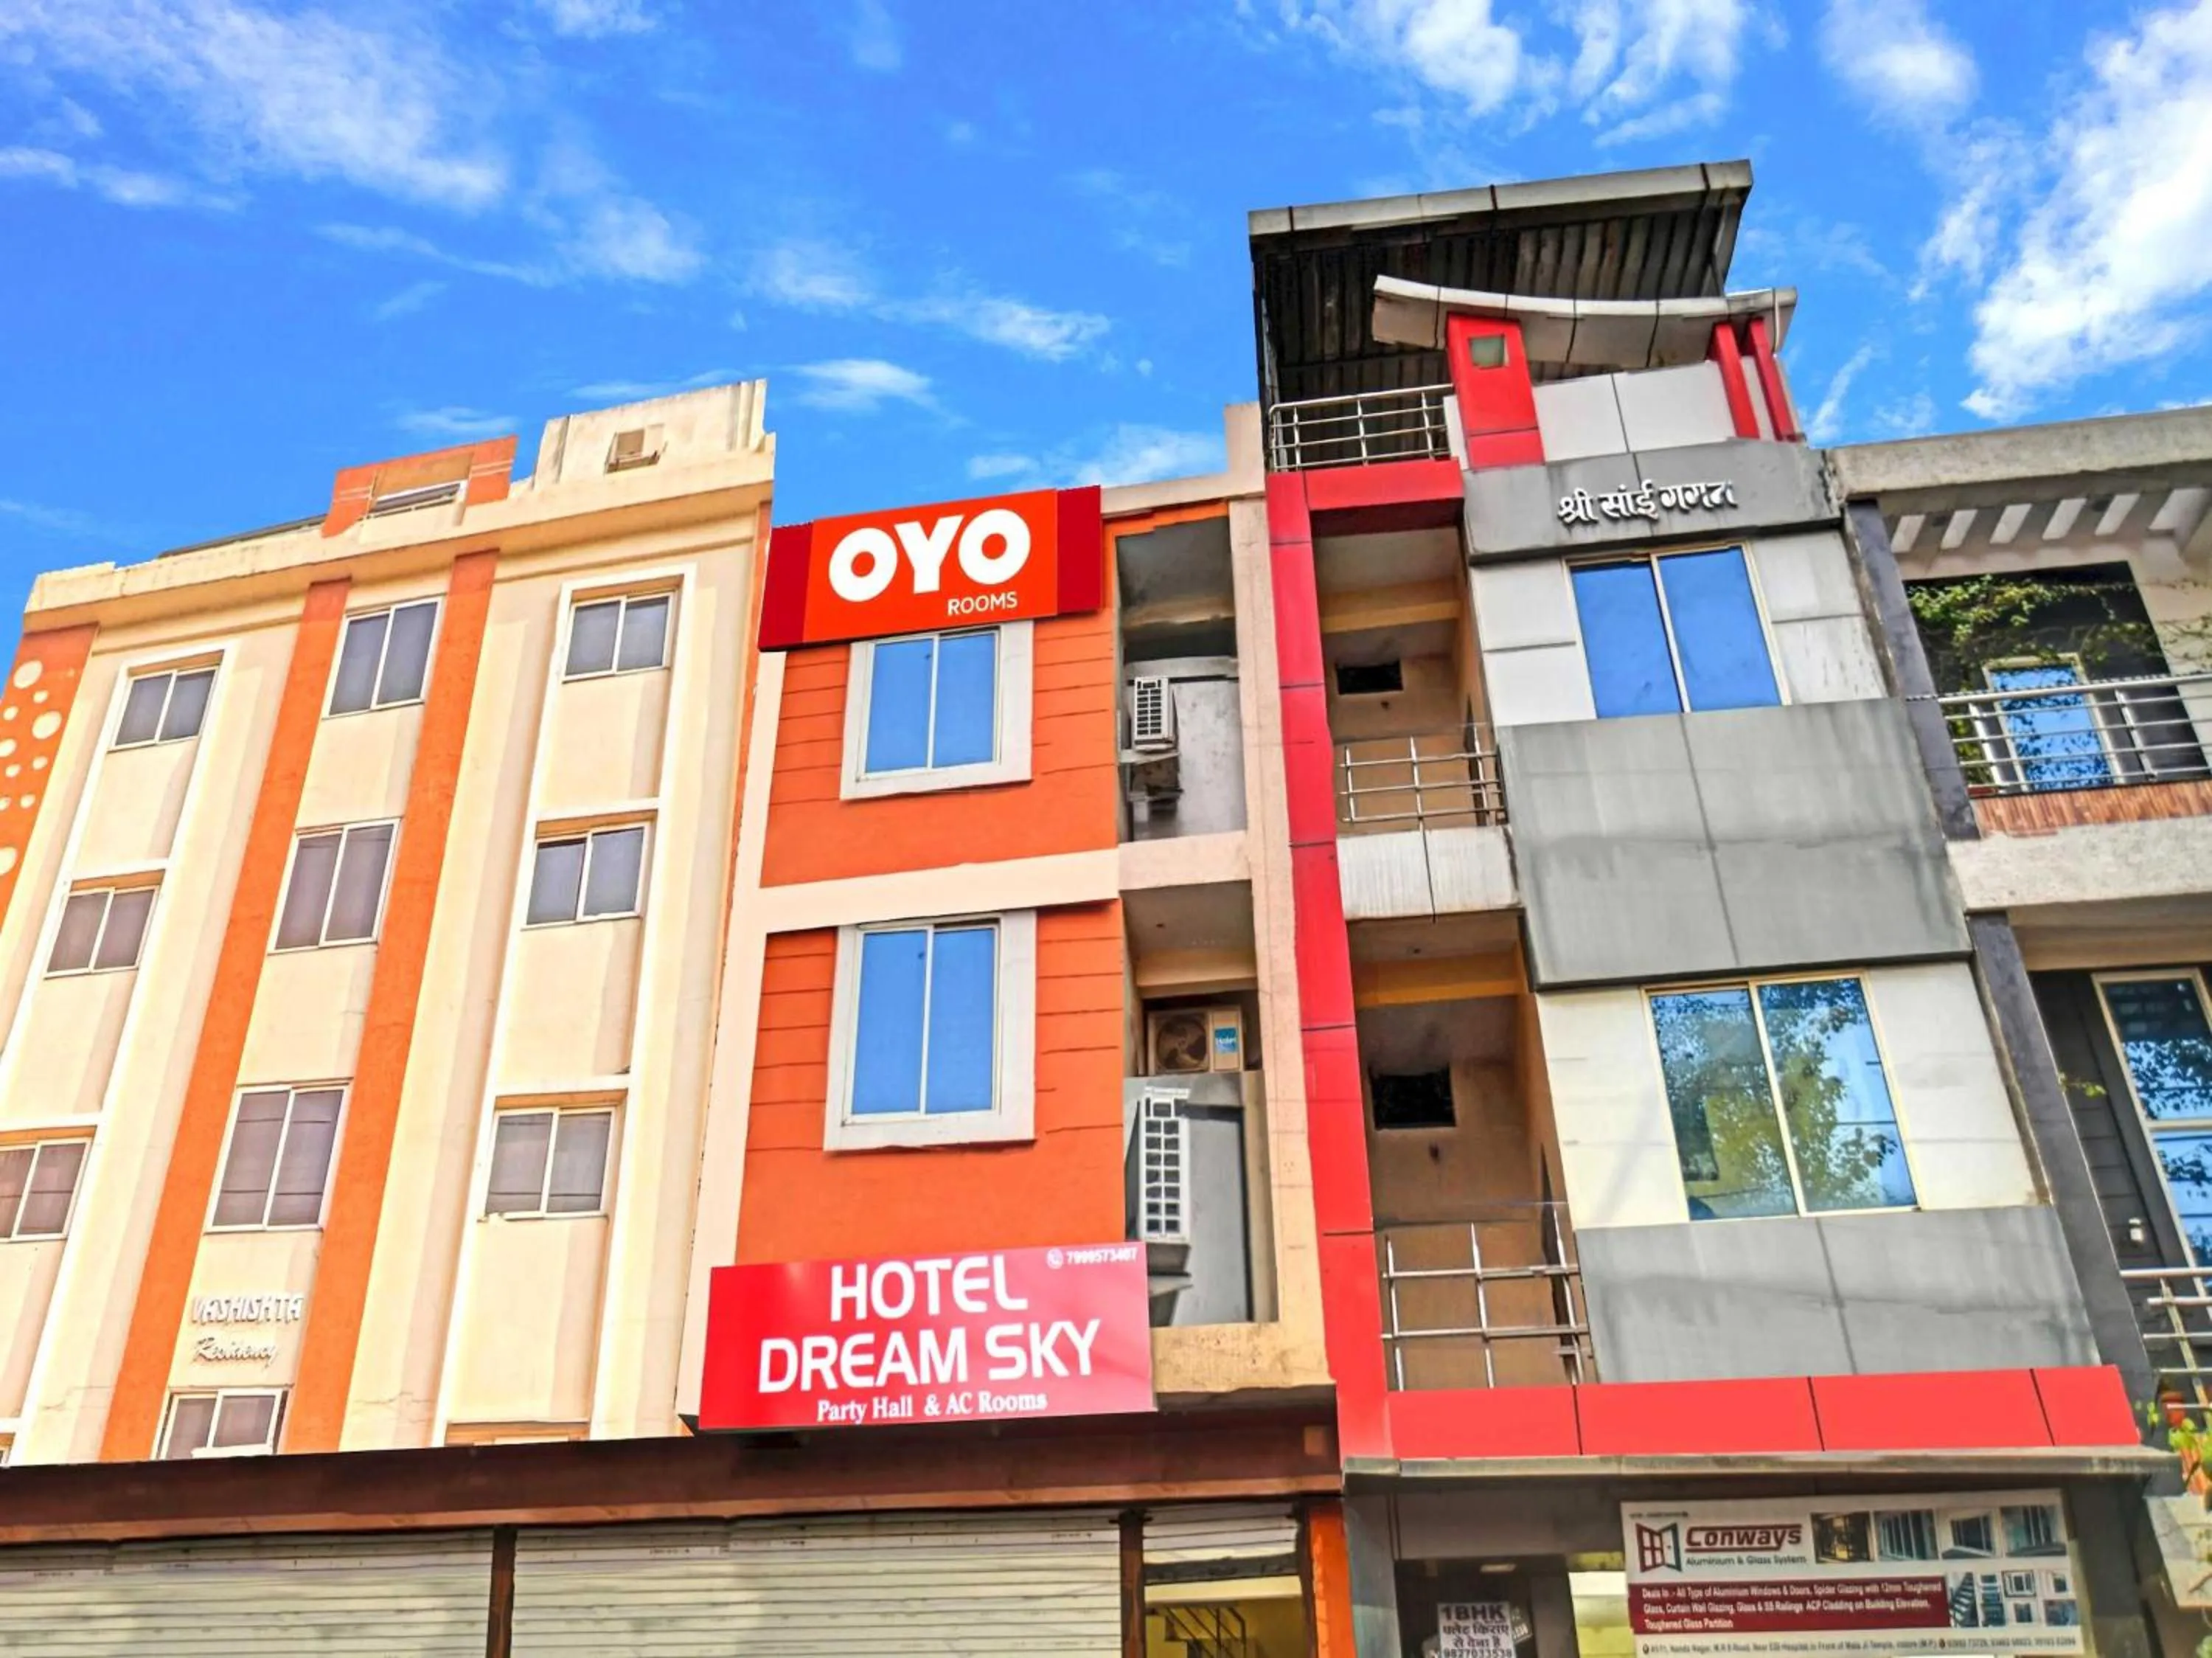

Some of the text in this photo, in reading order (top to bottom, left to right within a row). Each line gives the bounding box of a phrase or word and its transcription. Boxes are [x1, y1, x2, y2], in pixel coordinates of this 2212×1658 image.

[1557, 488, 1599, 522] श्री
[828, 508, 1032, 603] OYO
[947, 591, 1018, 616] ROOMS
[830, 1255, 1029, 1322] HOTEL
[758, 1318, 1101, 1393] DREAM SKY
[817, 1391, 1048, 1425] Party Hall & AC Rooms
[1686, 1524, 1802, 1553] Conways
[1747, 1555, 1771, 1564] Glass
[1687, 1586, 1703, 1599] Type
[1704, 1586, 1711, 1597] of
[1441, 1605, 1506, 1621] 1BHK
